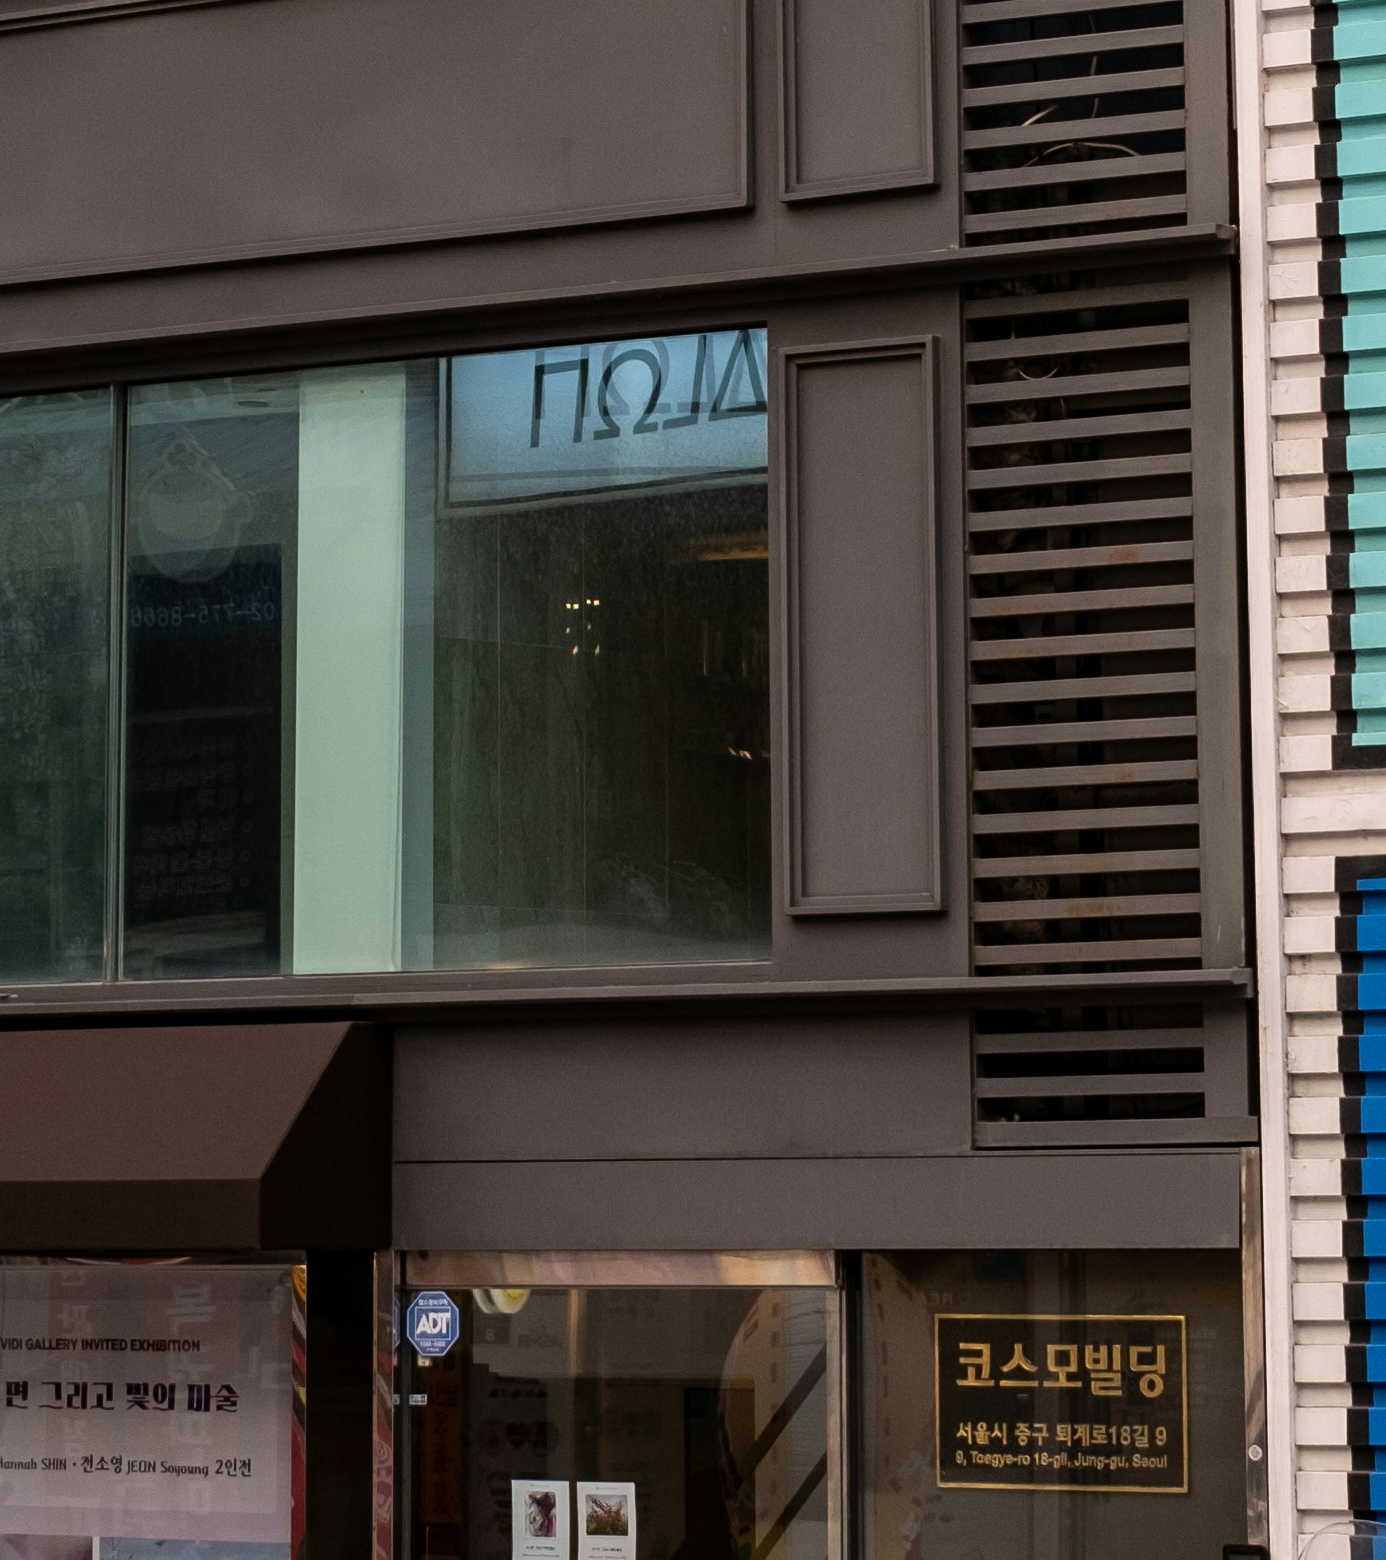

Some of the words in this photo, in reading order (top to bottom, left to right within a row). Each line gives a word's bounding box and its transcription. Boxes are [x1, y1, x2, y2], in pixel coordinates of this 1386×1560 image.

[416, 1312, 451, 1335] ADT
[0, 1337, 23, 1351] VIDI
[25, 1338, 78, 1351] GALLERY
[81, 1339, 128, 1352] INVITED
[130, 1339, 200, 1353] EXHIBITION
[955, 1342, 1166, 1398] 코스모빌딩
[39, 1381, 116, 1410] 그리고
[125, 1382, 177, 1411] 빛의
[956, 1421, 1008, 1445] 서울시
[1014, 1423, 1049, 1446] 중구
[1055, 1423, 1150, 1448] 퇴계로18길
[1154, 1426, 1167, 1447] 9
[41, 1458, 68, 1471] SHIN
[126, 1460, 157, 1475] JEON
[160, 1461, 209, 1478] Soyoung
[214, 1458, 252, 1477] 2인전
[1074, 1453, 1130, 1469] Jung-gu,
[1132, 1454, 1167, 1468] Seoul
